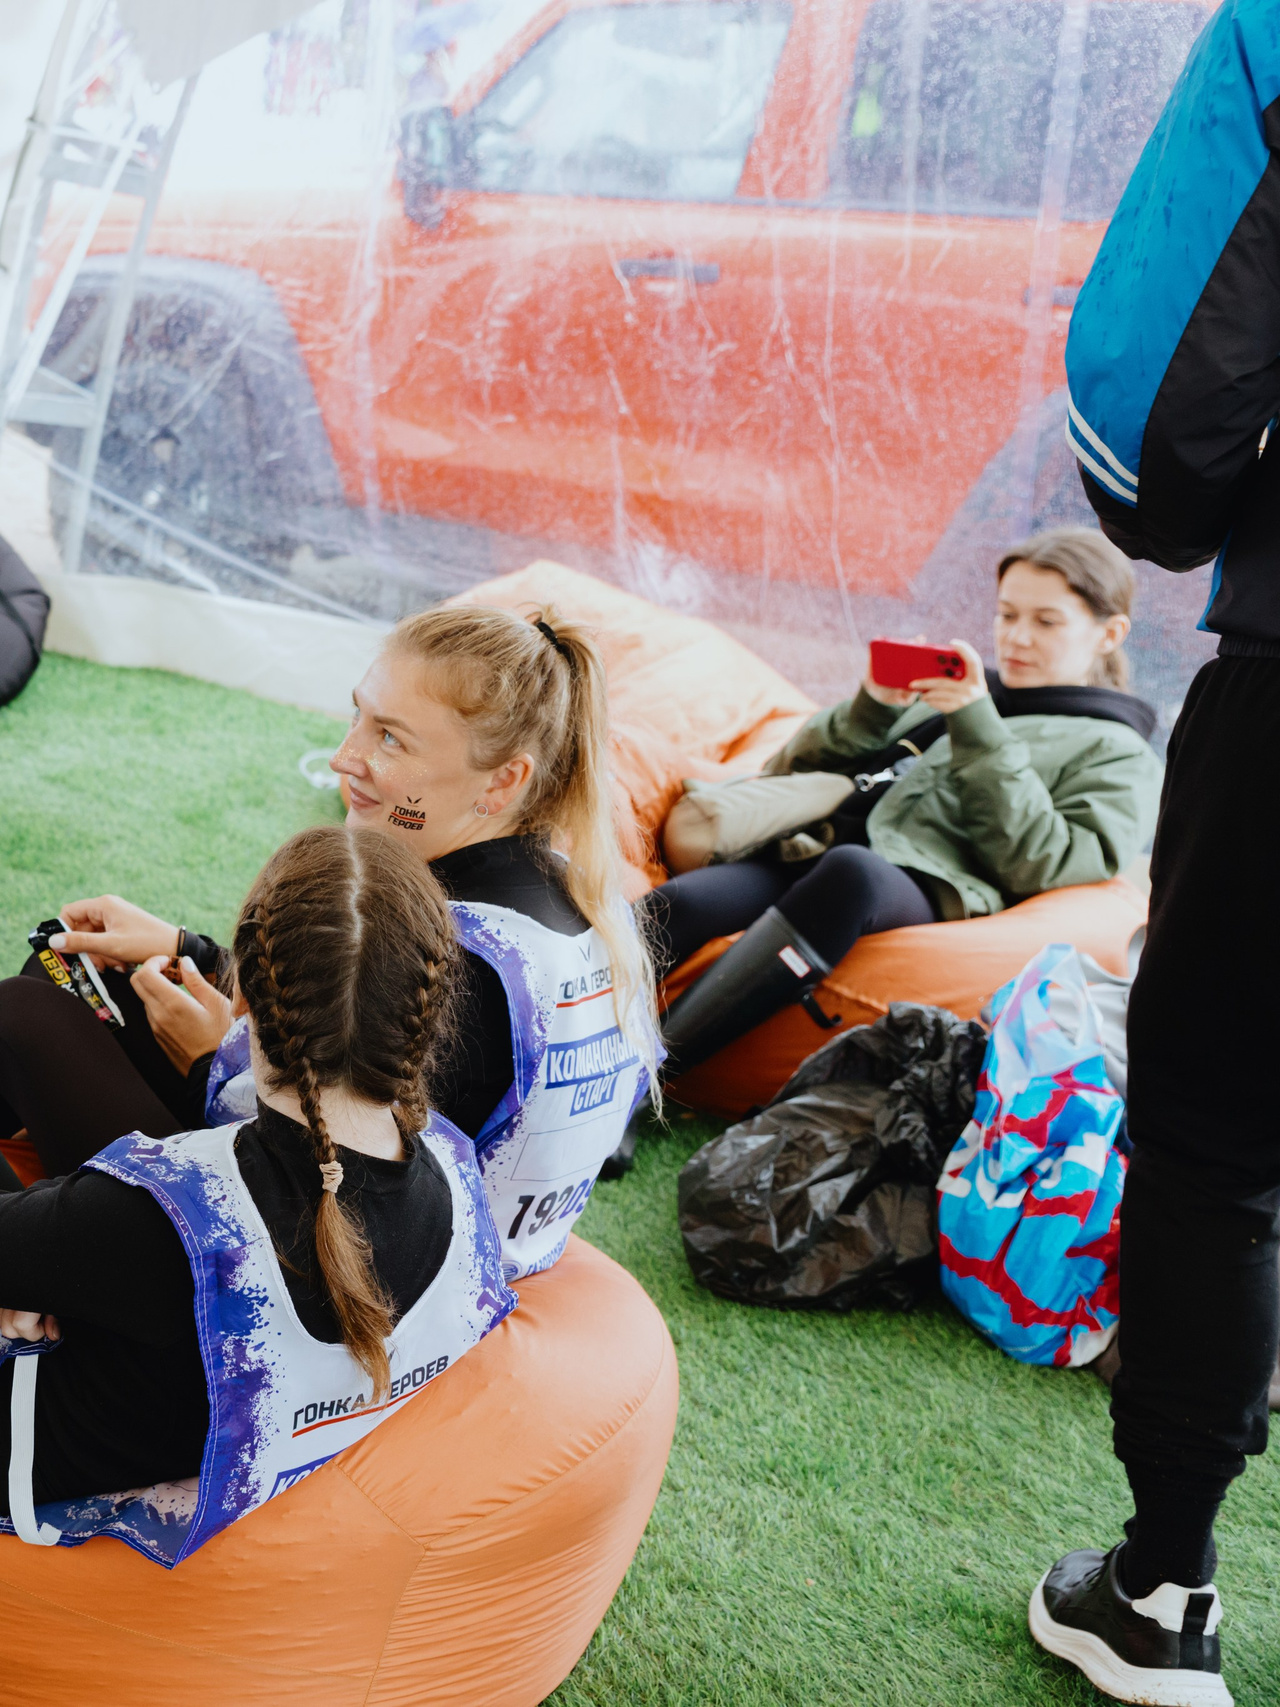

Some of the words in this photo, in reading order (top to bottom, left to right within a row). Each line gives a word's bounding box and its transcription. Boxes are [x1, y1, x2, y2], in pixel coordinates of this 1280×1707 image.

[387, 814, 424, 831] ГЕРОЕВ
[394, 805, 426, 819] ГОНКА
[42, 950, 67, 982] GEL
[590, 966, 612, 991] ГЕРО
[573, 1072, 618, 1111] СТАРТ
[292, 1393, 366, 1430] ГОНКА
[386, 1355, 449, 1400] ЕРОЕВ
